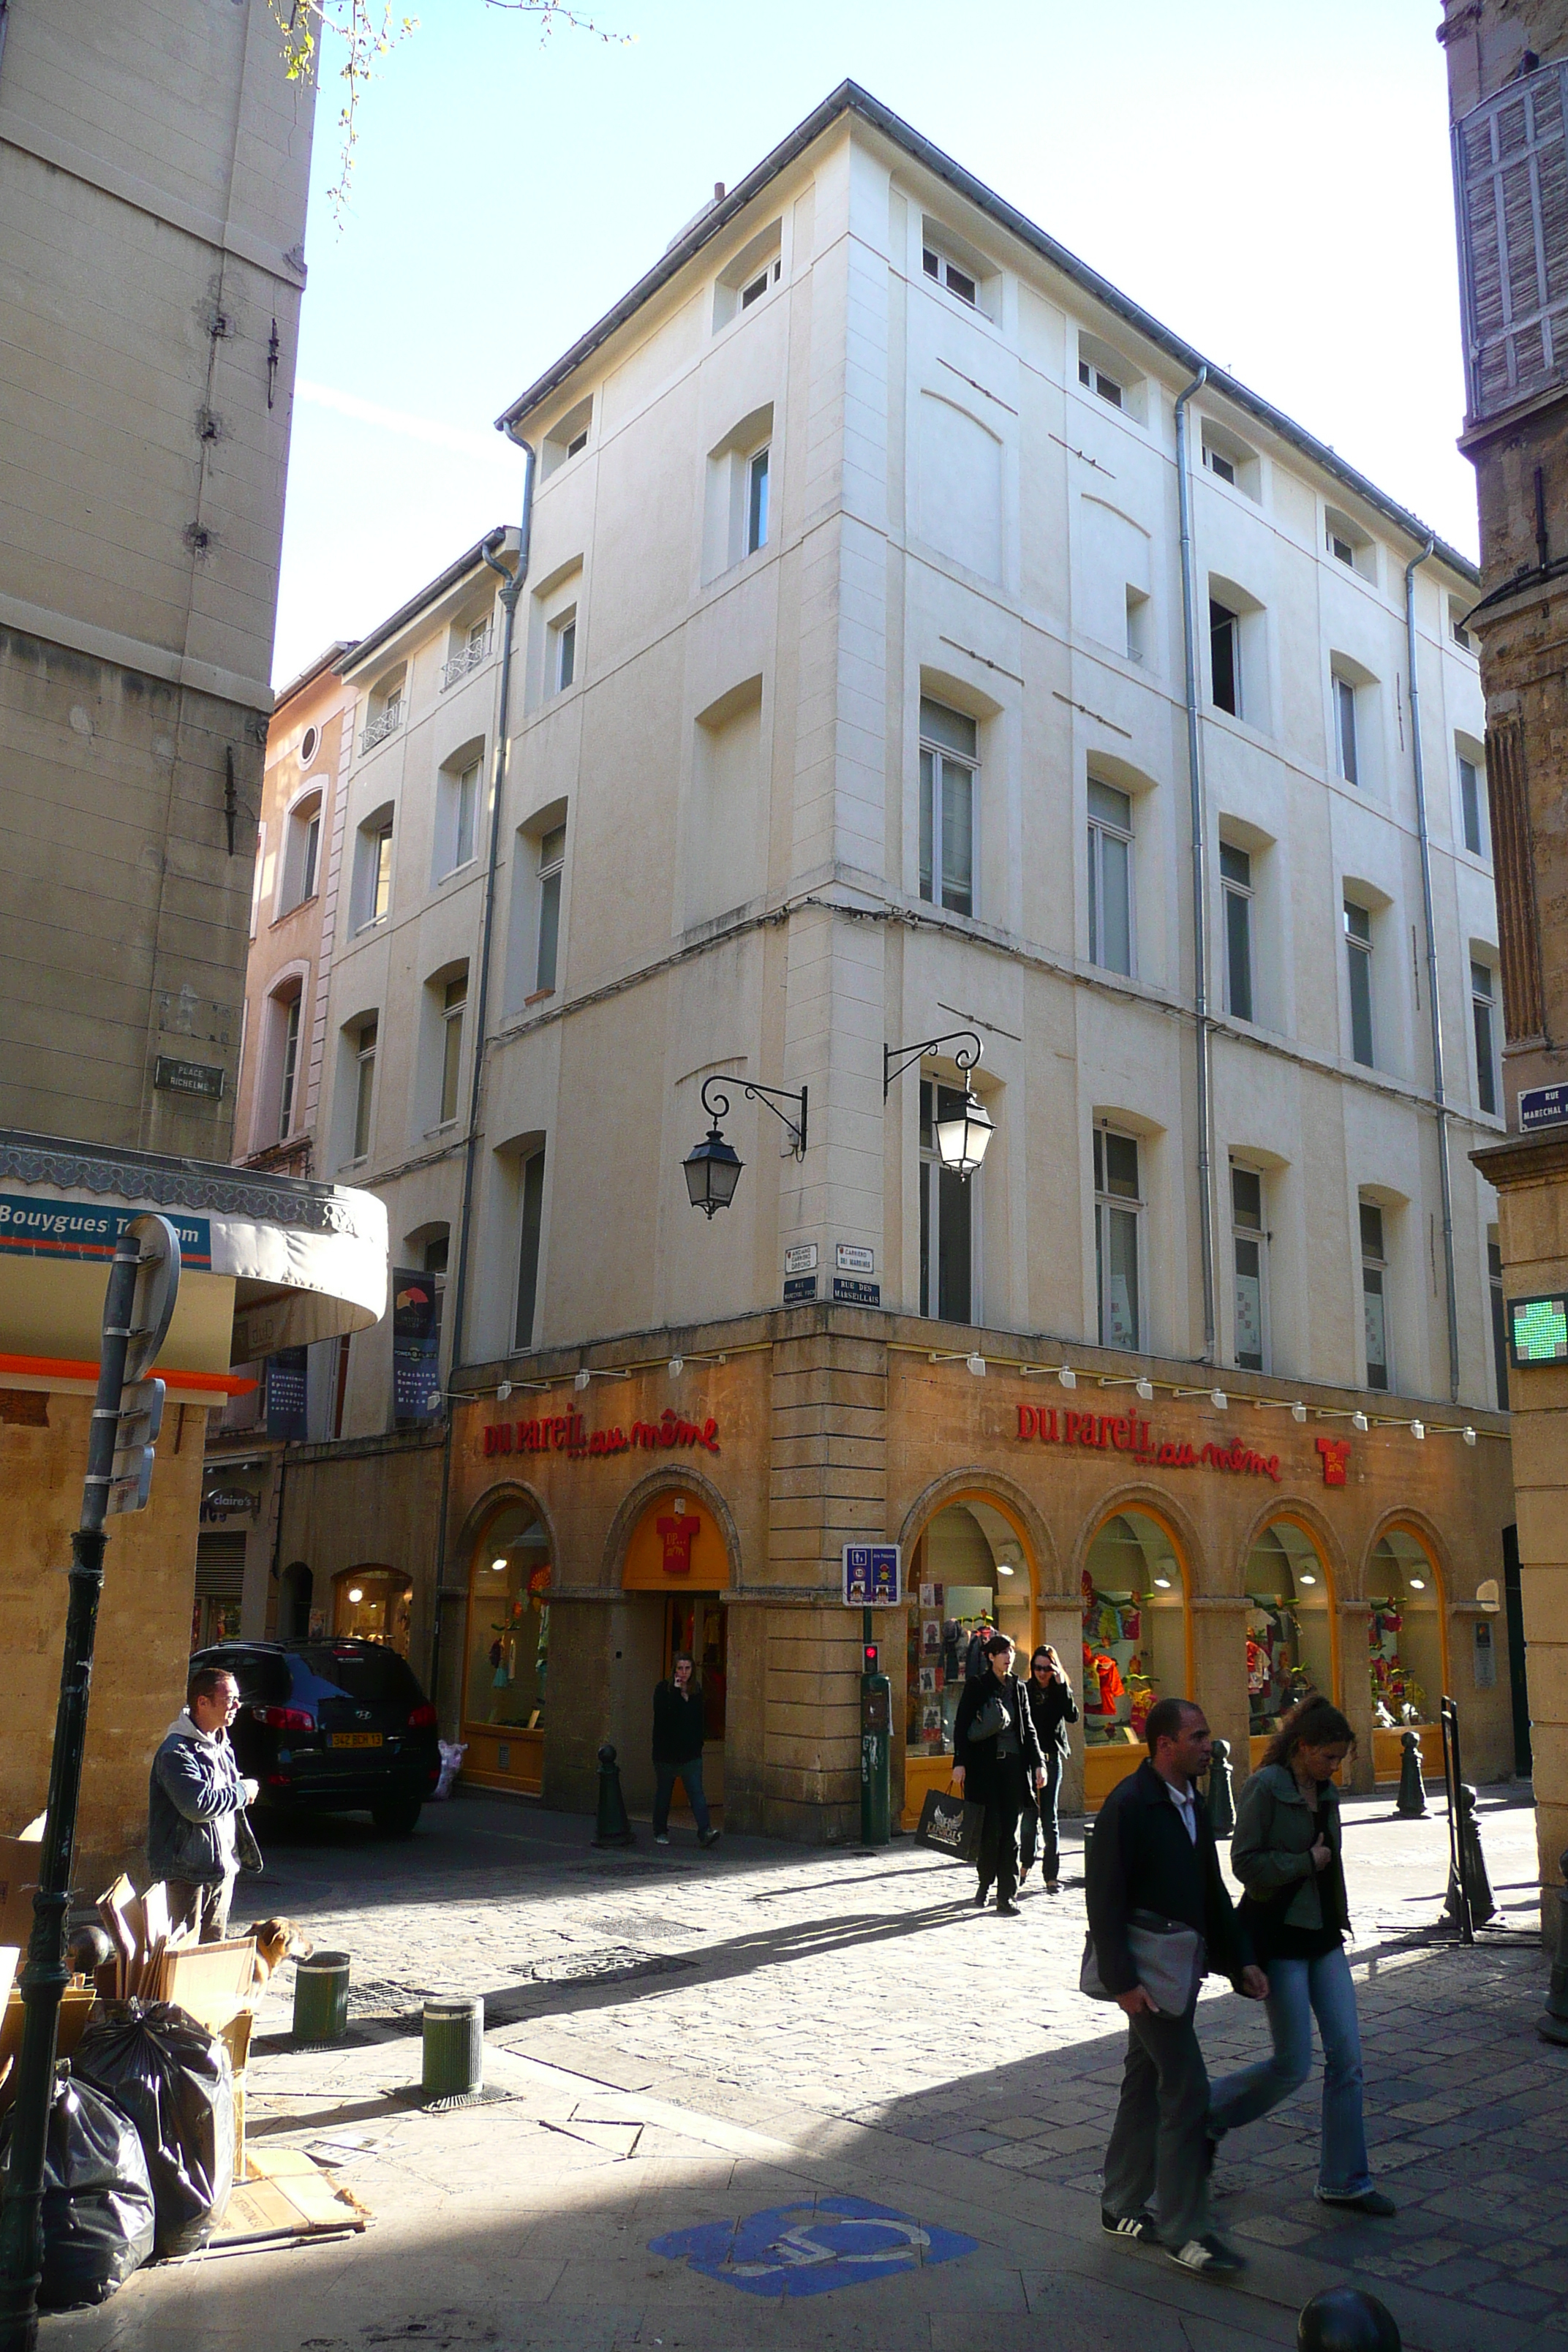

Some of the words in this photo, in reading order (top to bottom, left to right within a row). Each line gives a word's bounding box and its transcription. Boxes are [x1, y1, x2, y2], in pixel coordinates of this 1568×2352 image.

[178, 1066, 203, 1077] PLACE
[170, 1077, 208, 1091] RICHELME
[1545, 1090, 1559, 1101] RUE
[0, 1205, 108, 1233] Bouygues
[840, 1281, 854, 1289] RUE
[859, 1284, 872, 1292] DES
[834, 1289, 878, 1303] MARSEILLAIS
[214, 1494, 252, 1506] claire's
